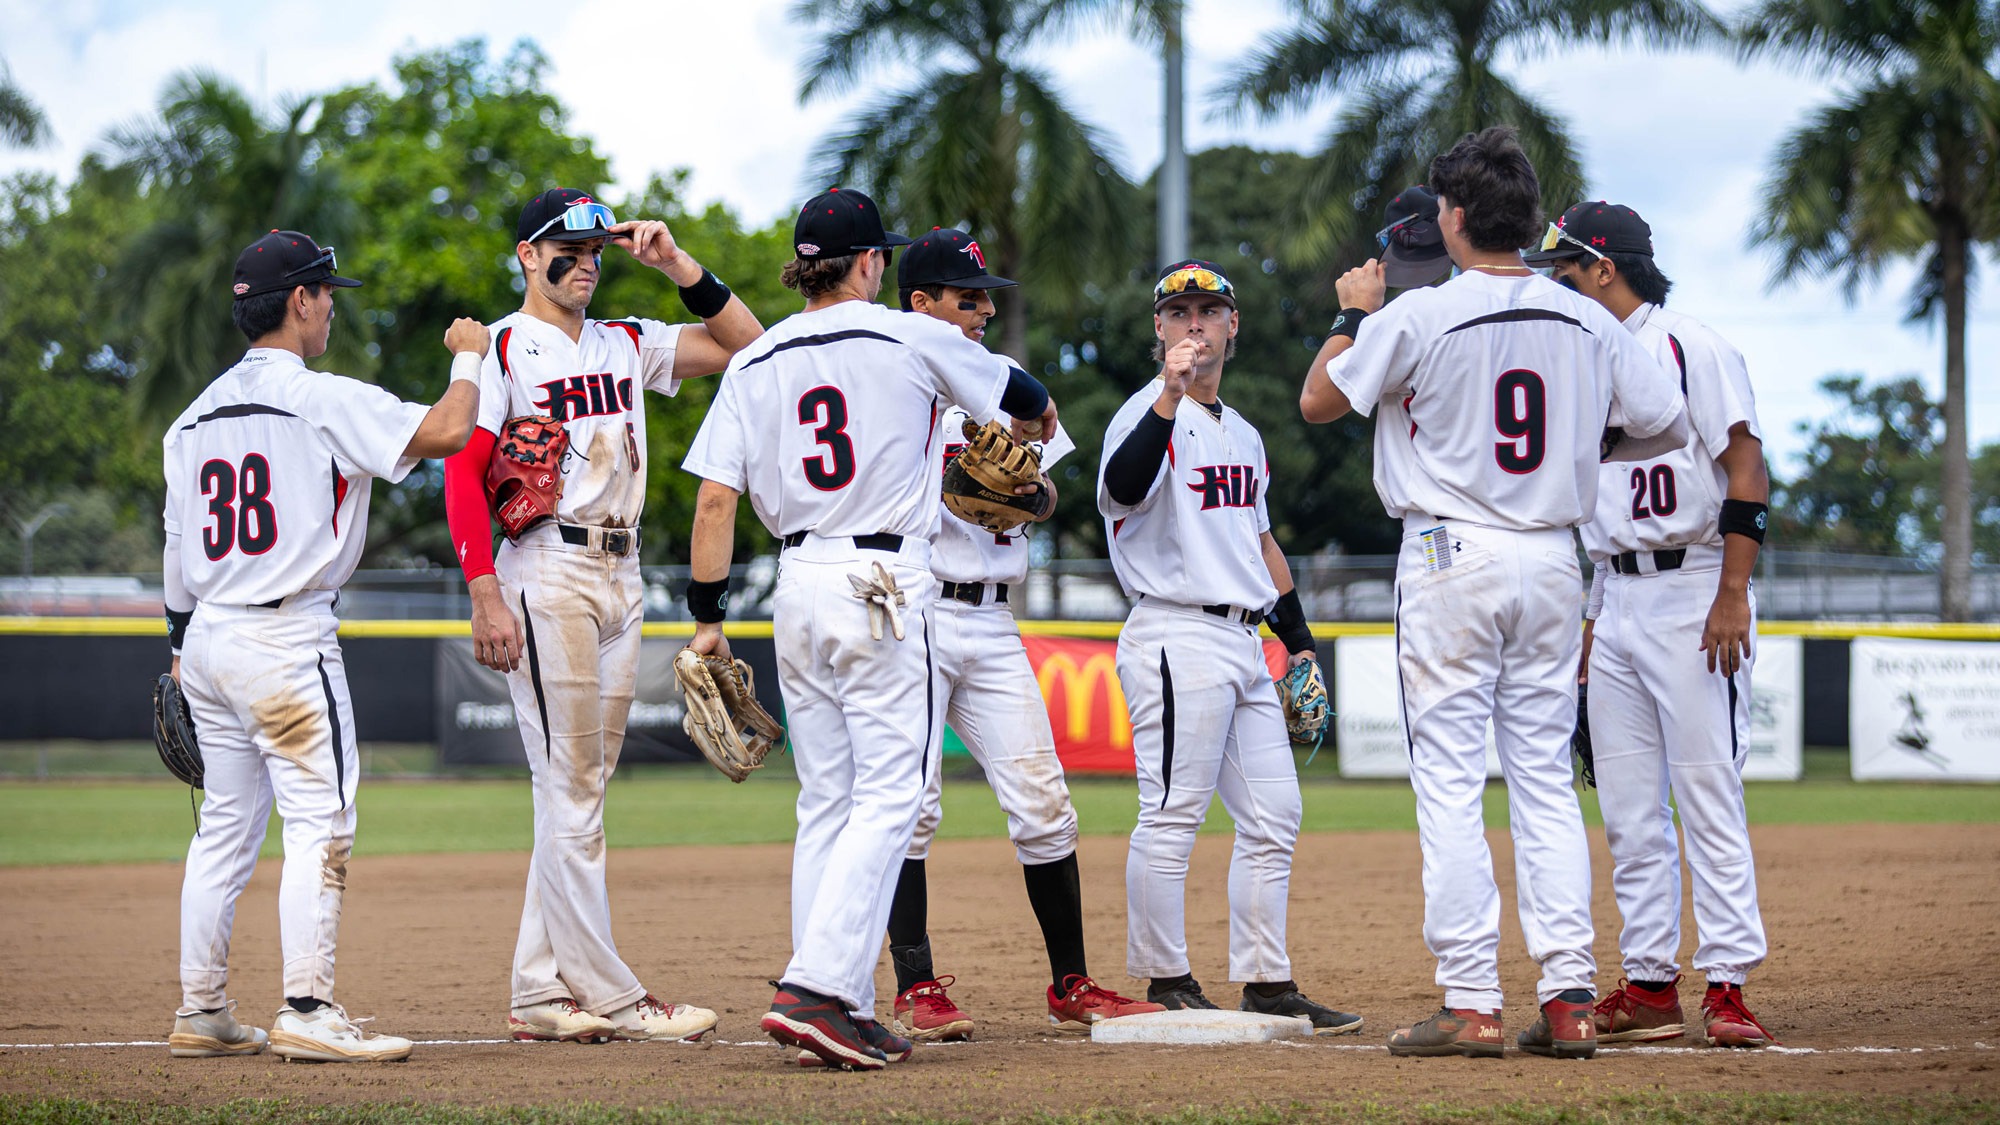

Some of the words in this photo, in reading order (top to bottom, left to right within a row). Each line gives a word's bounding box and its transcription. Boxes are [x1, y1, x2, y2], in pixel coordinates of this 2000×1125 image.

[797, 385, 856, 491] 3
[1494, 368, 1546, 475] 9
[200, 452, 278, 561] 38
[1630, 463, 1677, 520] 20
[1478, 1025, 1499, 1038] John
